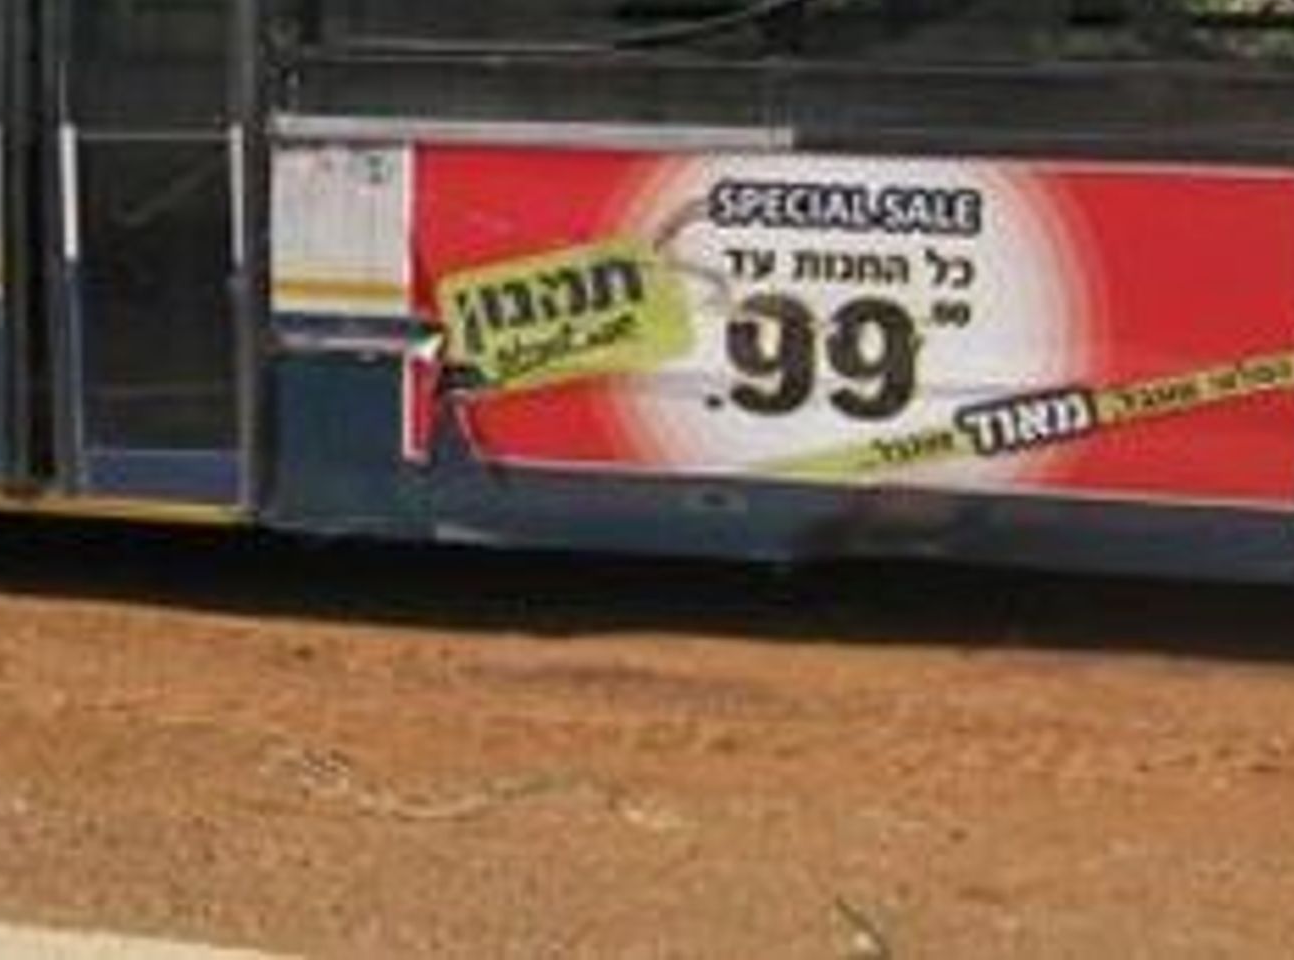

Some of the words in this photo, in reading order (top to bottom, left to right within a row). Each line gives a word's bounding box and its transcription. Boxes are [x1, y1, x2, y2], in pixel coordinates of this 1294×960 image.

[711, 182, 873, 230] SPECIAL
[879, 188, 981, 235] SALE
[724, 248, 776, 280] עד
[924, 246, 975, 288] כל
[957, 385, 1098, 457] מאוד
